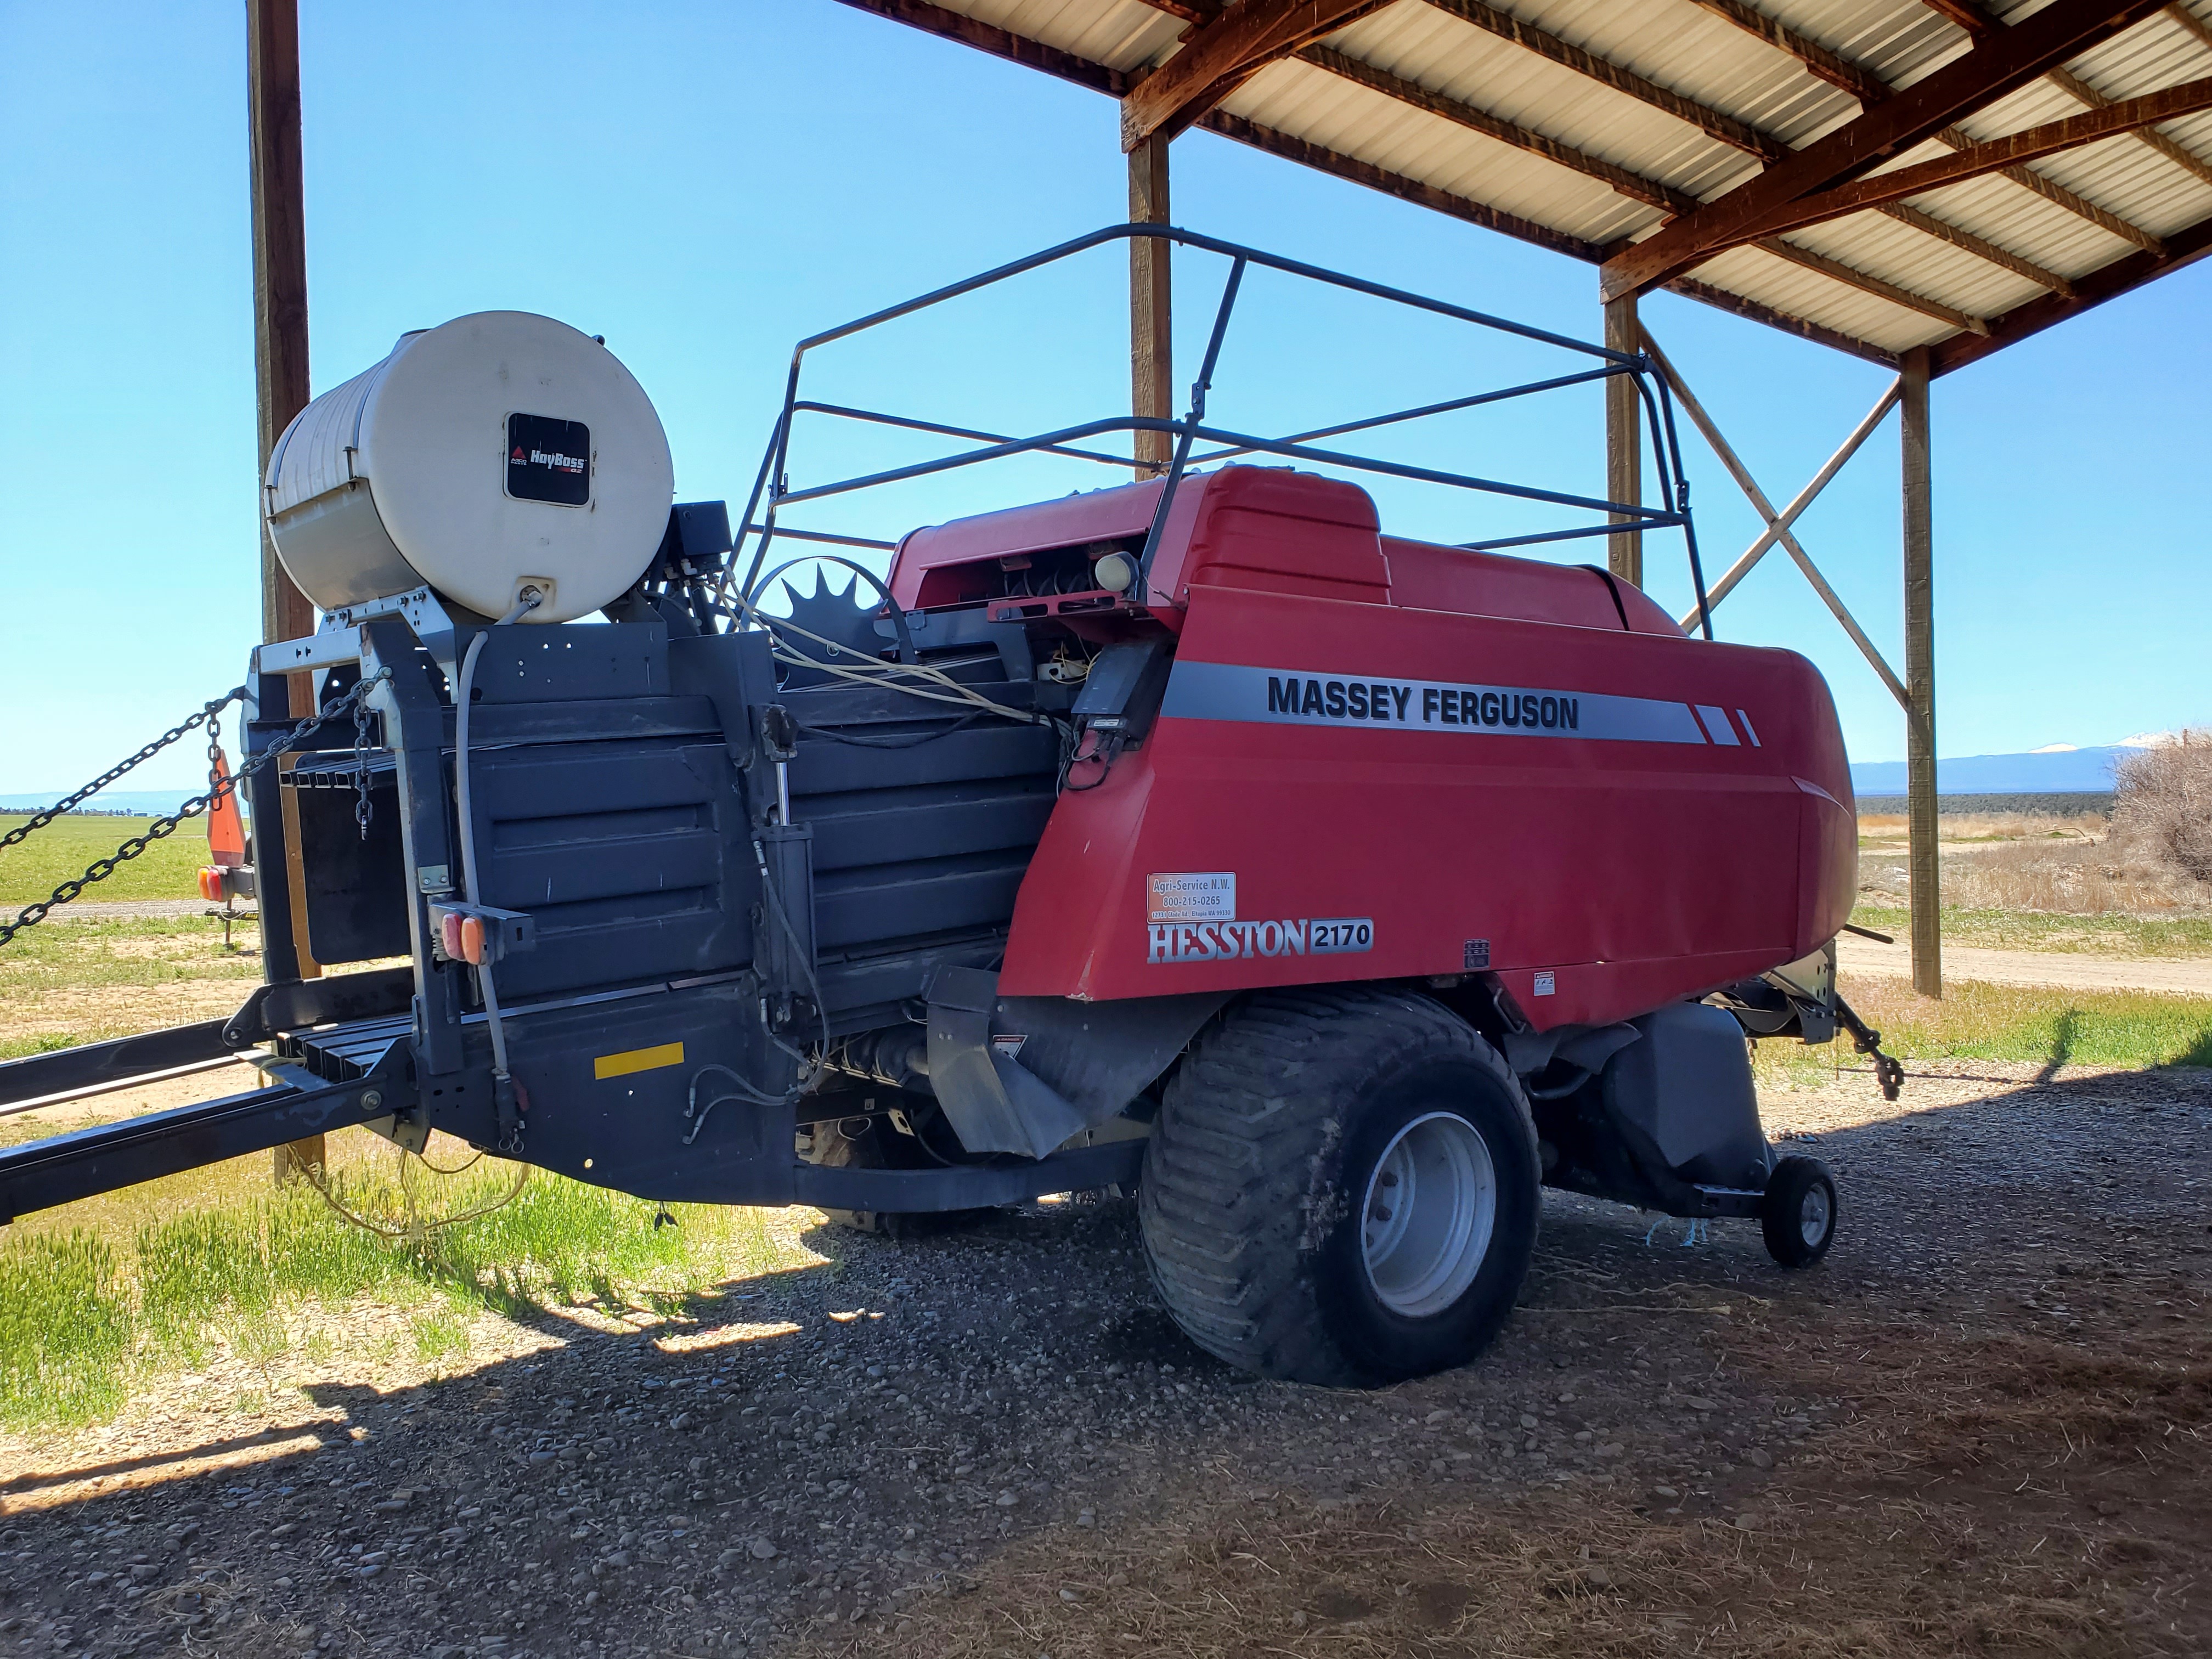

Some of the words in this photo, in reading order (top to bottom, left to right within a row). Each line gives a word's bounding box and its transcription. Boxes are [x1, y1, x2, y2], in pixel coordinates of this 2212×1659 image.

[531, 450, 584, 469] HayBoss
[1268, 676, 1411, 720] MASSEY
[1423, 687, 1578, 730] FERGUSON
[1153, 879, 1208, 894] Agri-Service
[1211, 878, 1230, 890] N.W.
[1163, 895, 1221, 907] 800-215-0265
[1147, 919, 1308, 963] HESSTON
[1314, 924, 1369, 947] 2170
